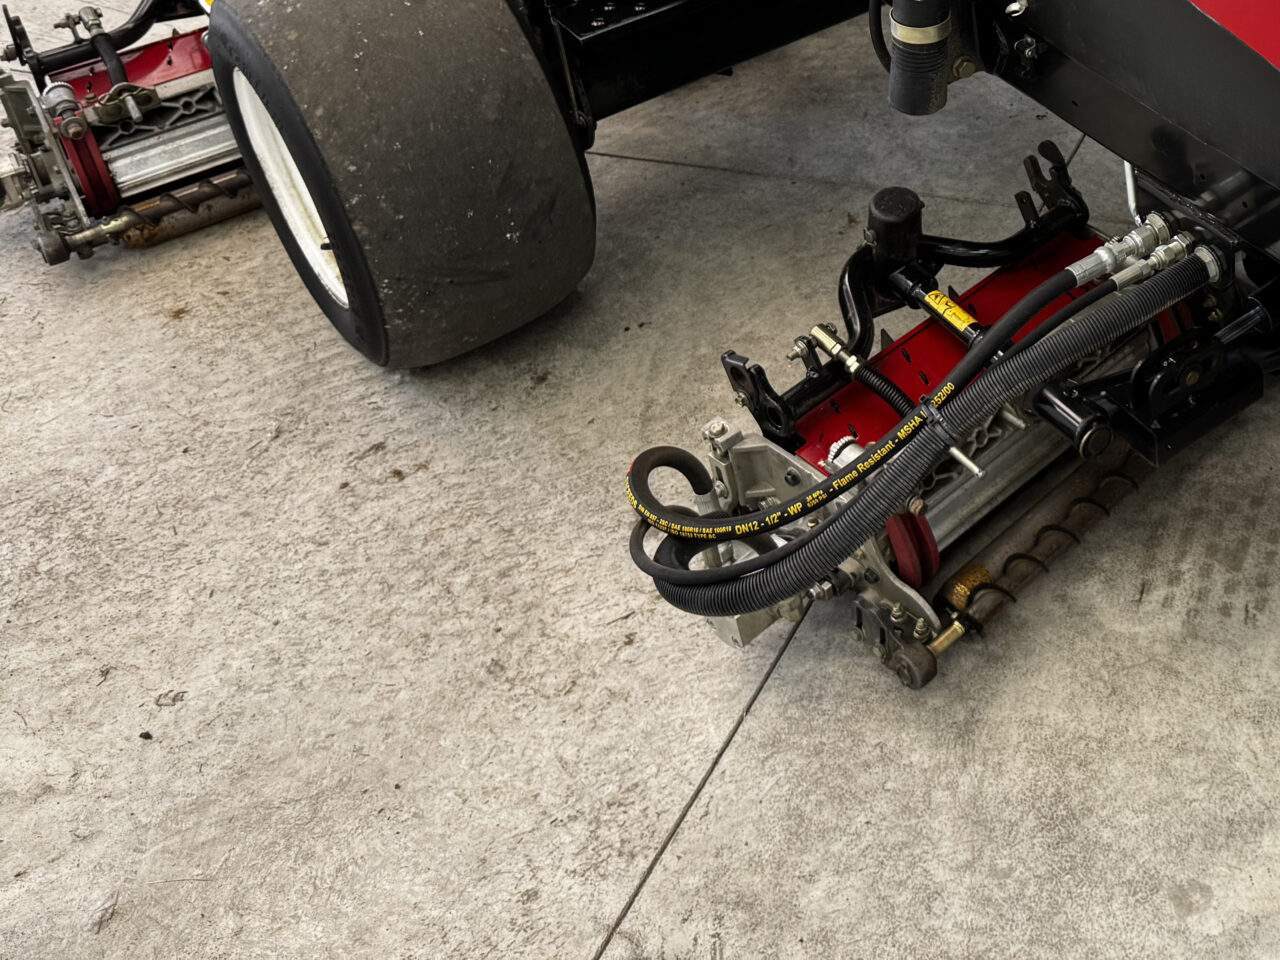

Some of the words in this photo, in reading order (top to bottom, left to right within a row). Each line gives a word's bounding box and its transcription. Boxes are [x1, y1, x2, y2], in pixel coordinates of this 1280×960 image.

[832, 469, 859, 491] Flame
[856, 439, 896, 474] Resistant
[897, 415, 923, 441] MSHA
[734, 520, 760, 536] DN12
[787, 501, 804, 517] WP
